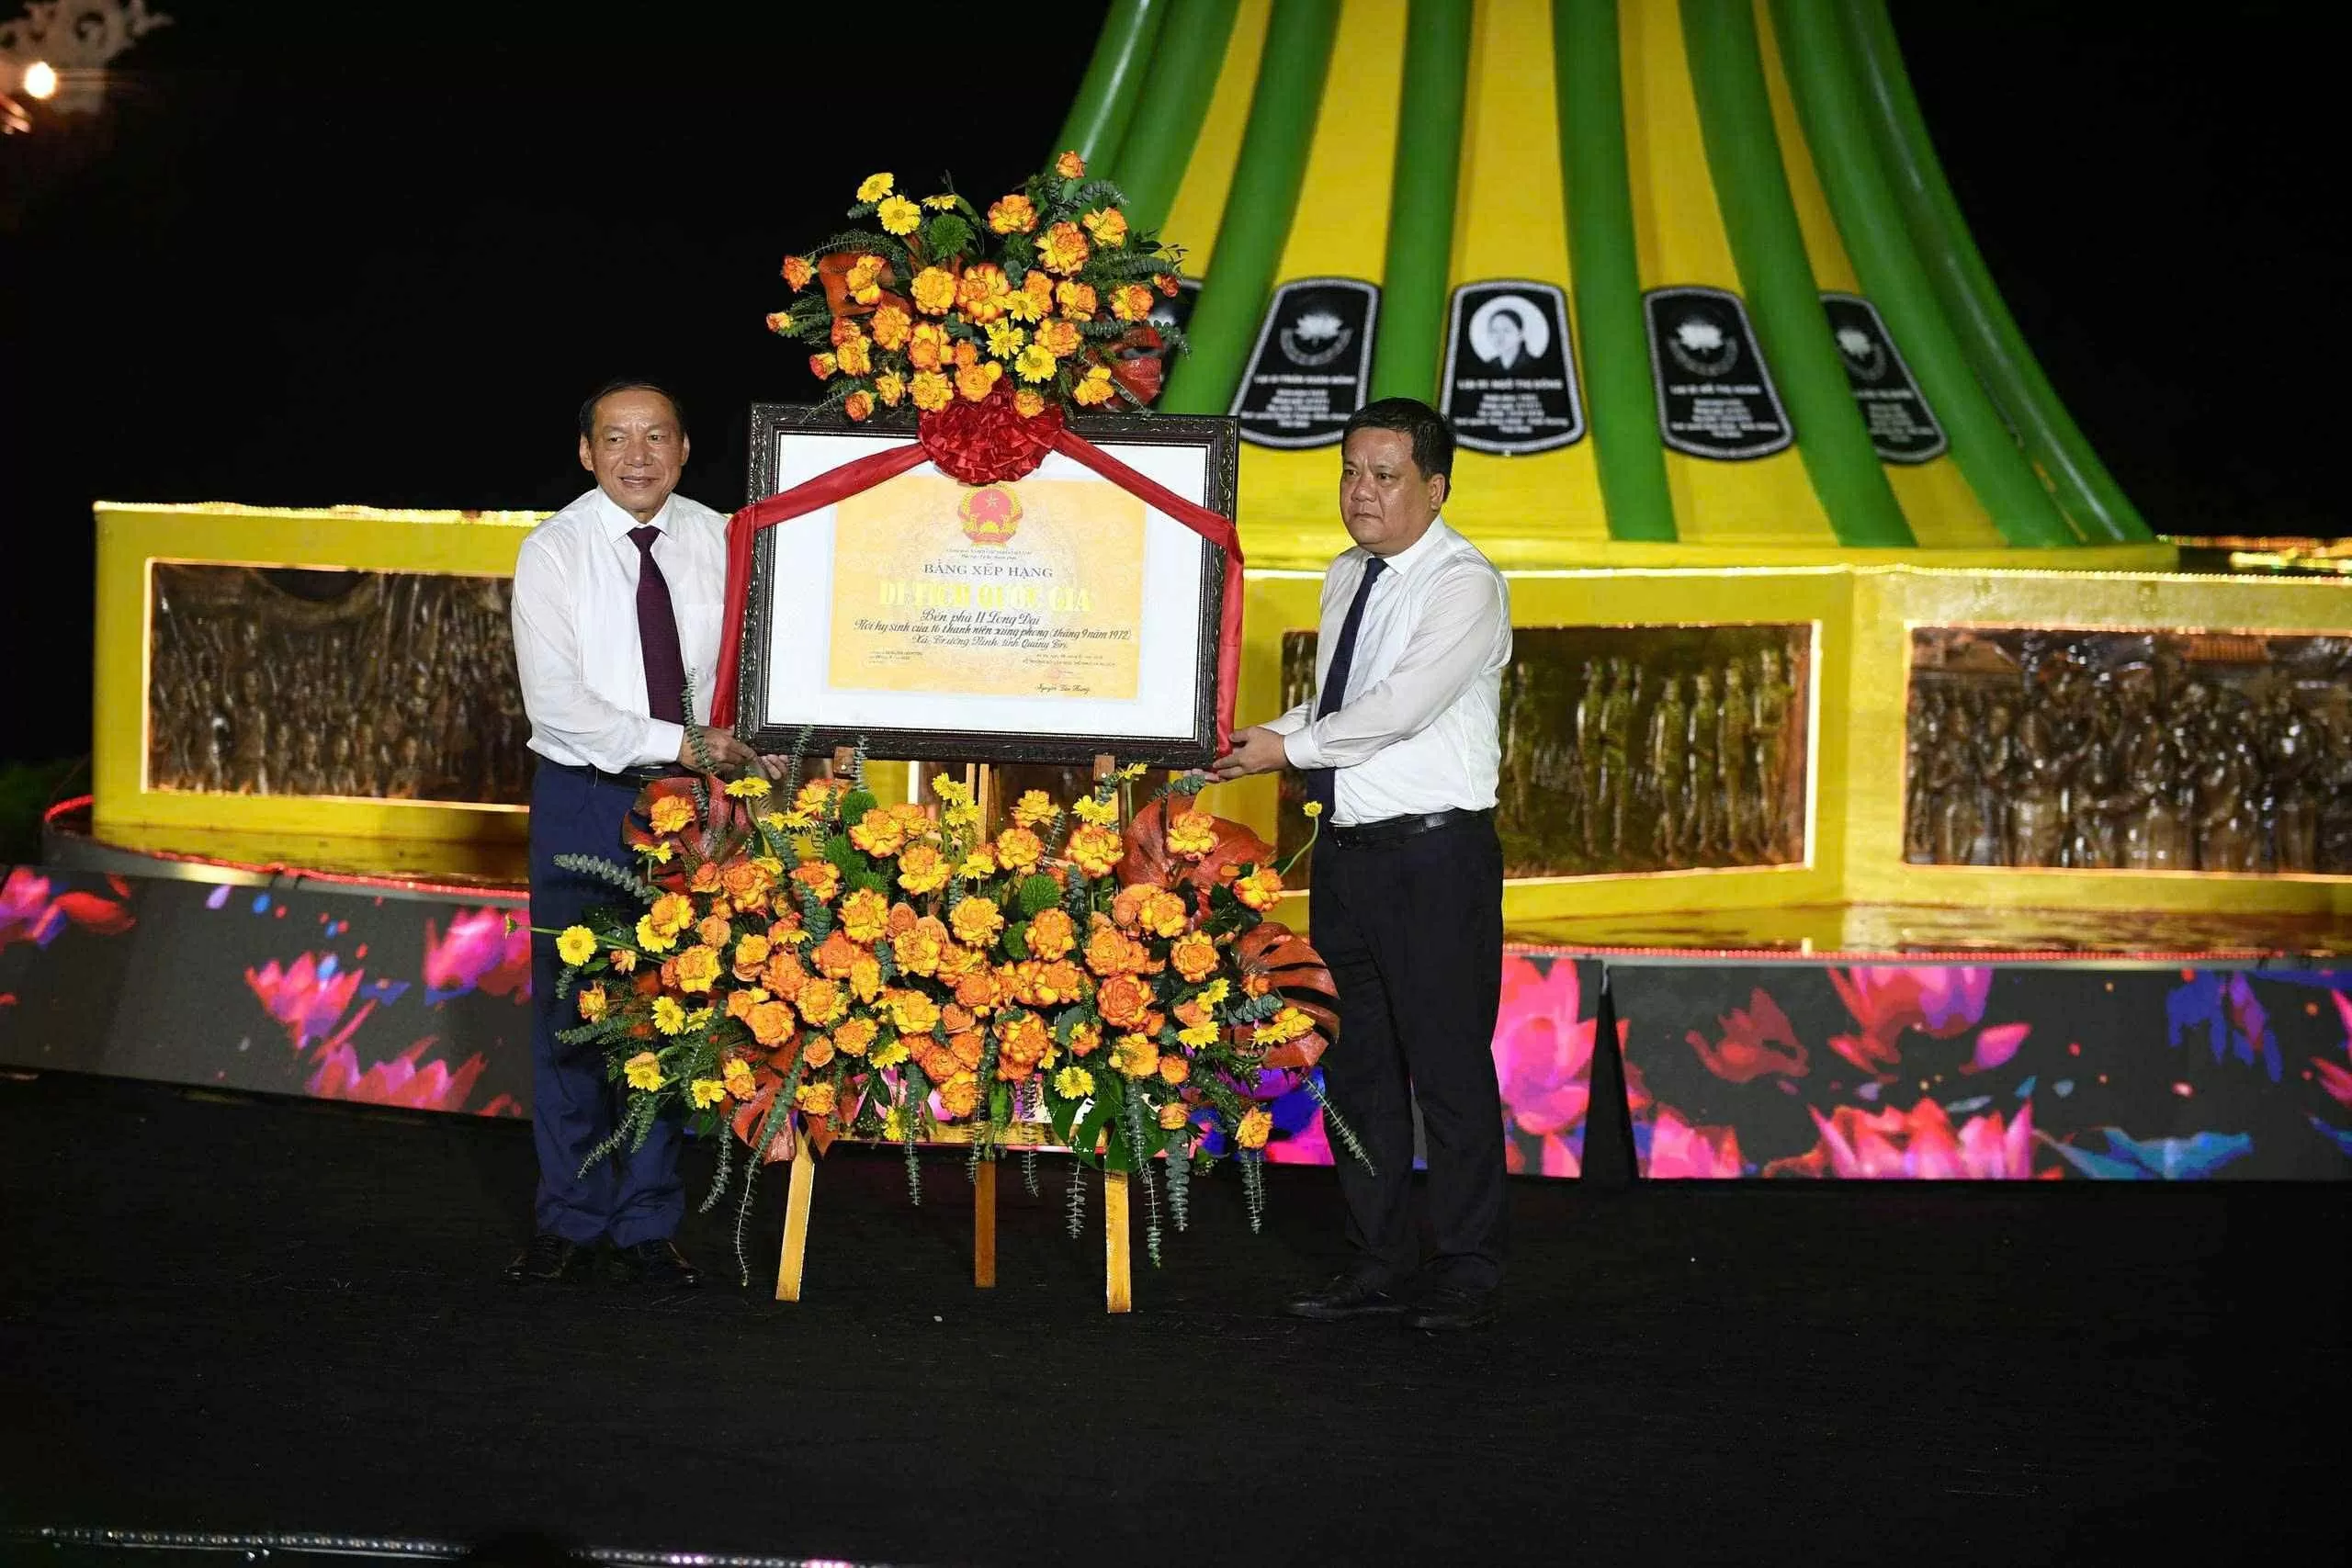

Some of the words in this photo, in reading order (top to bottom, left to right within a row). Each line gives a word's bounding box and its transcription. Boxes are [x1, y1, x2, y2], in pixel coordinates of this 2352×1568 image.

[922, 558, 967, 575] BẢNG
[970, 561, 1003, 577] XẾP
[1008, 566, 1053, 581] HẠNG
[888, 623, 909, 632] sinh
[942, 624, 971, 634] thanh
[972, 626, 992, 635] niên
[993, 627, 1020, 637] xung
[1020, 626, 1048, 639] phong
